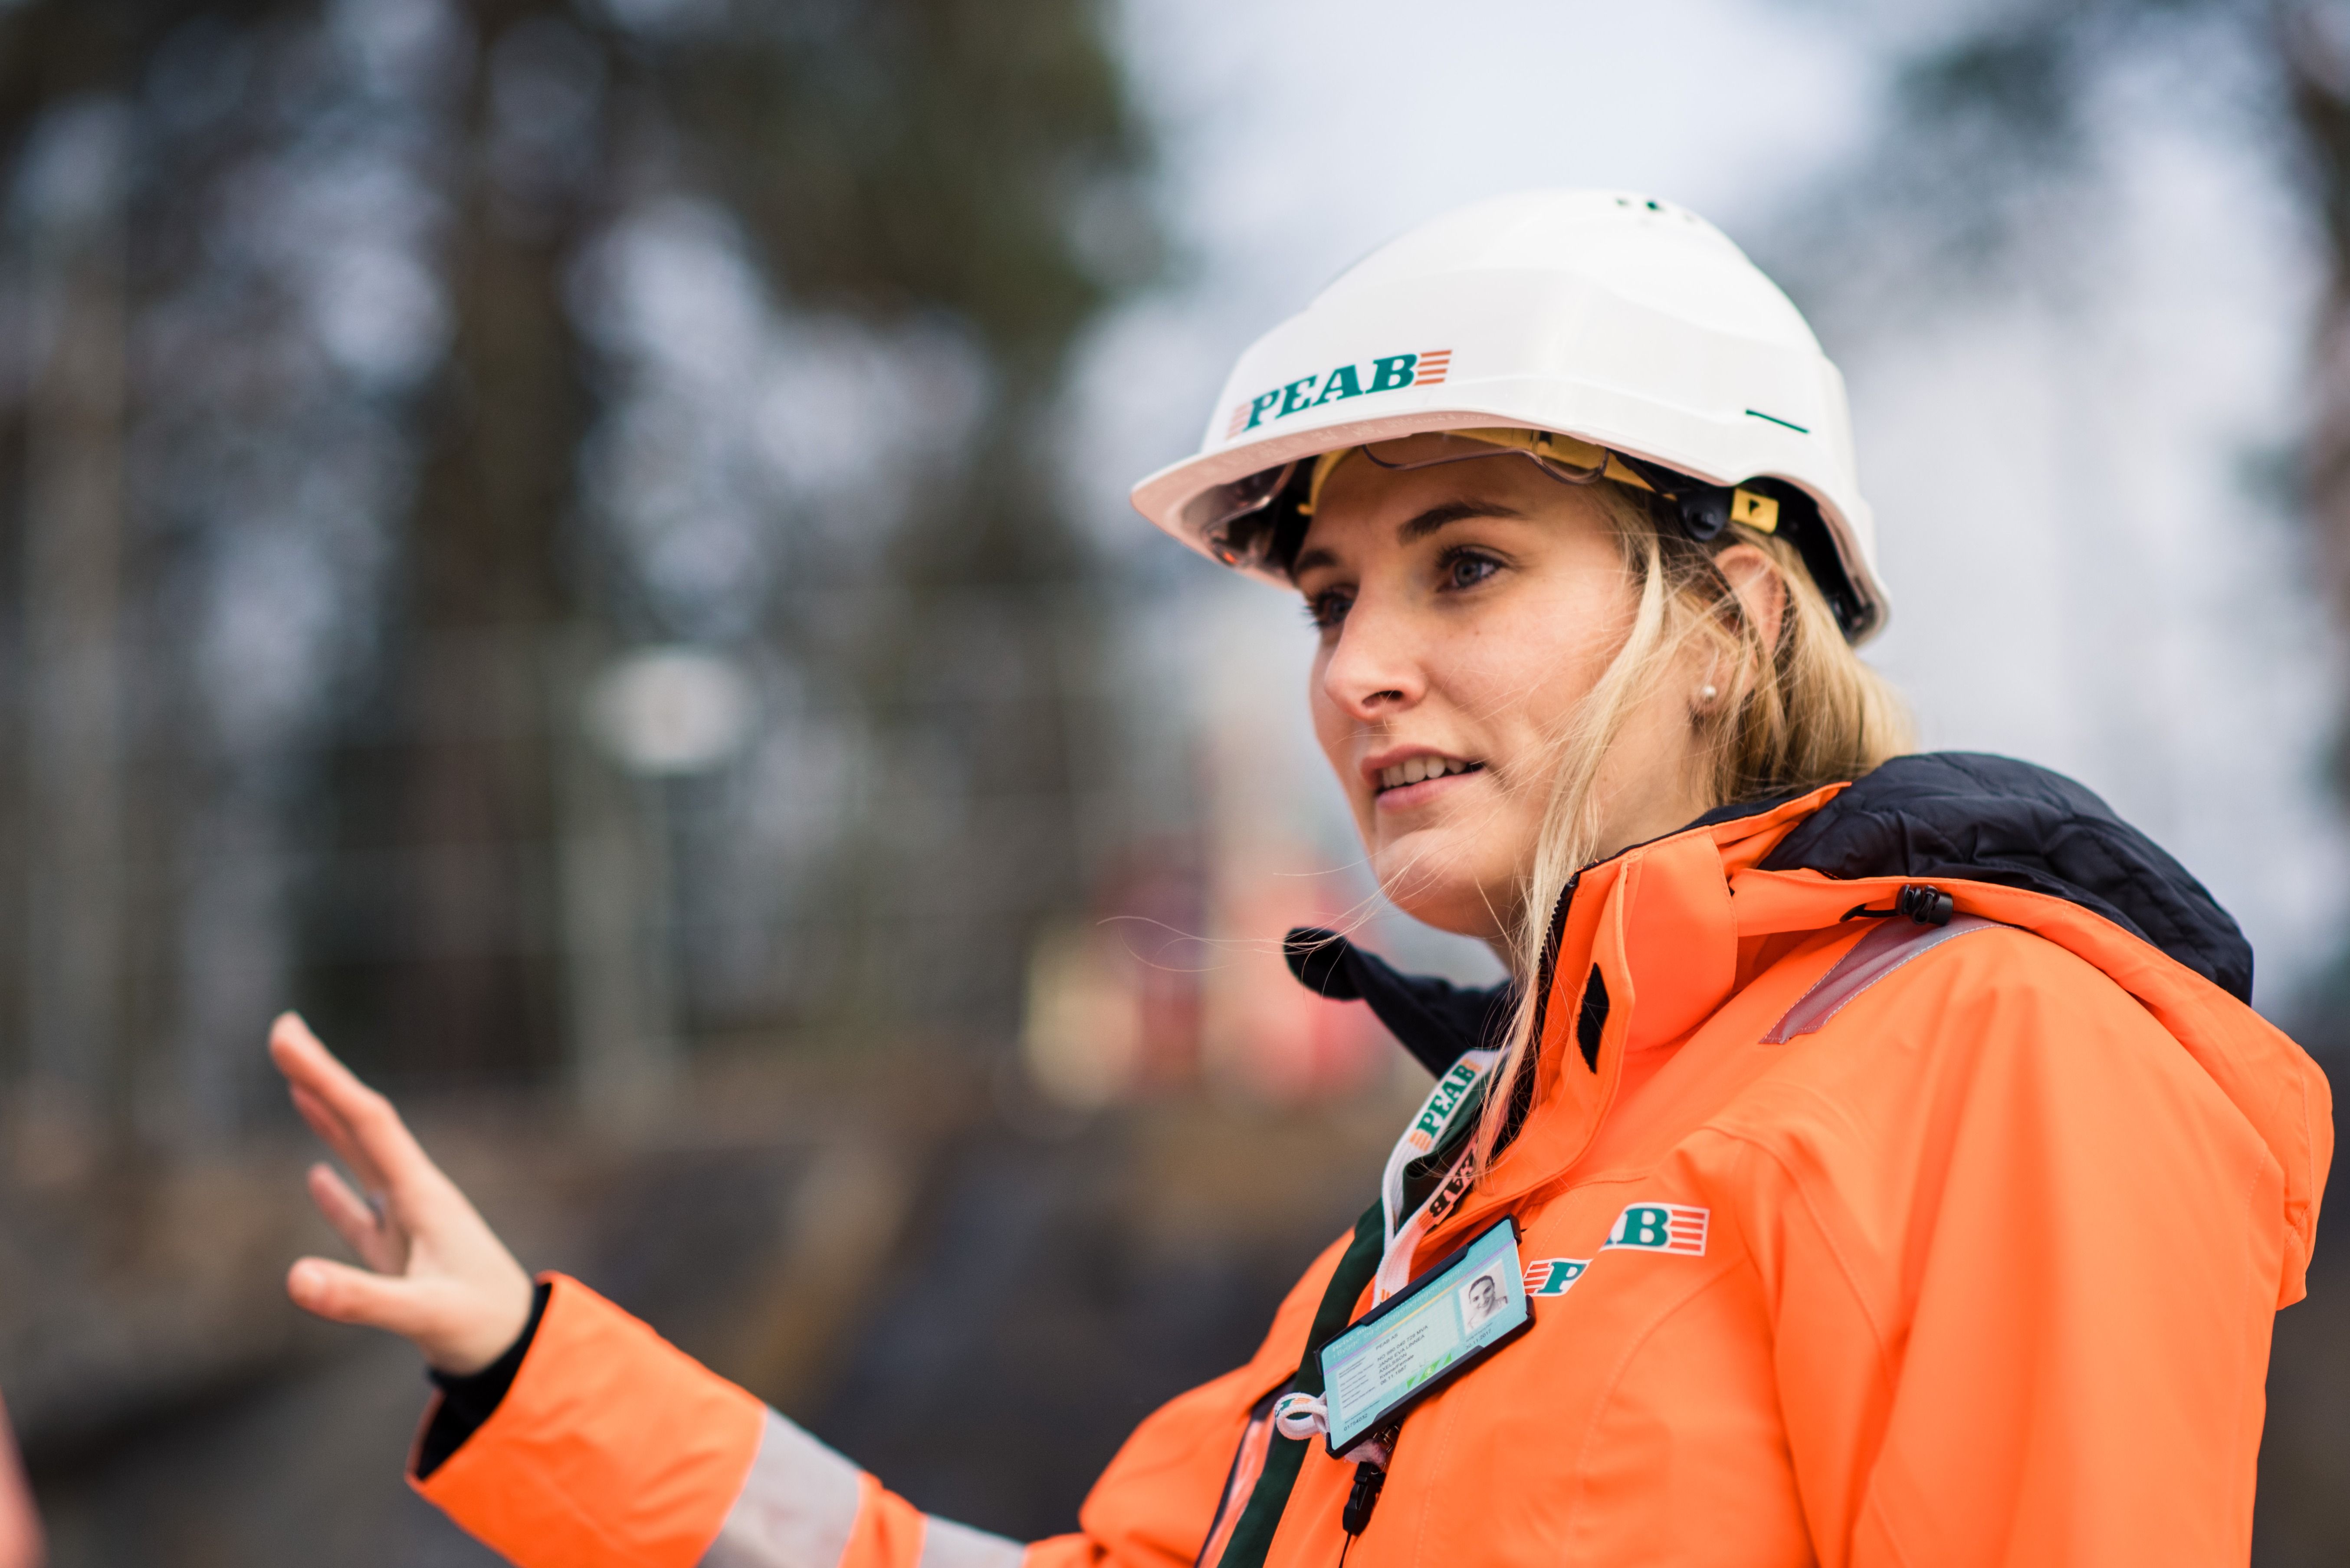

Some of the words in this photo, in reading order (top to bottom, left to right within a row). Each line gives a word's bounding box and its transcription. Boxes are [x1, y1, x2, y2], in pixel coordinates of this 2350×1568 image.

[1242, 353, 1417, 433] PEAB
[1416, 1064, 1475, 1139] PEAB
[1376, 1339, 1390, 1350] PEAB
[1397, 1340, 1405, 1348] 040
[1417, 1325, 1428, 1335] MVA
[1378, 1355, 1393, 1368] JANNI
[1395, 1348, 1405, 1357] EVA
[1406, 1335, 1425, 1349] LINNEA
[1379, 1352, 1407, 1374] AXELSSON
